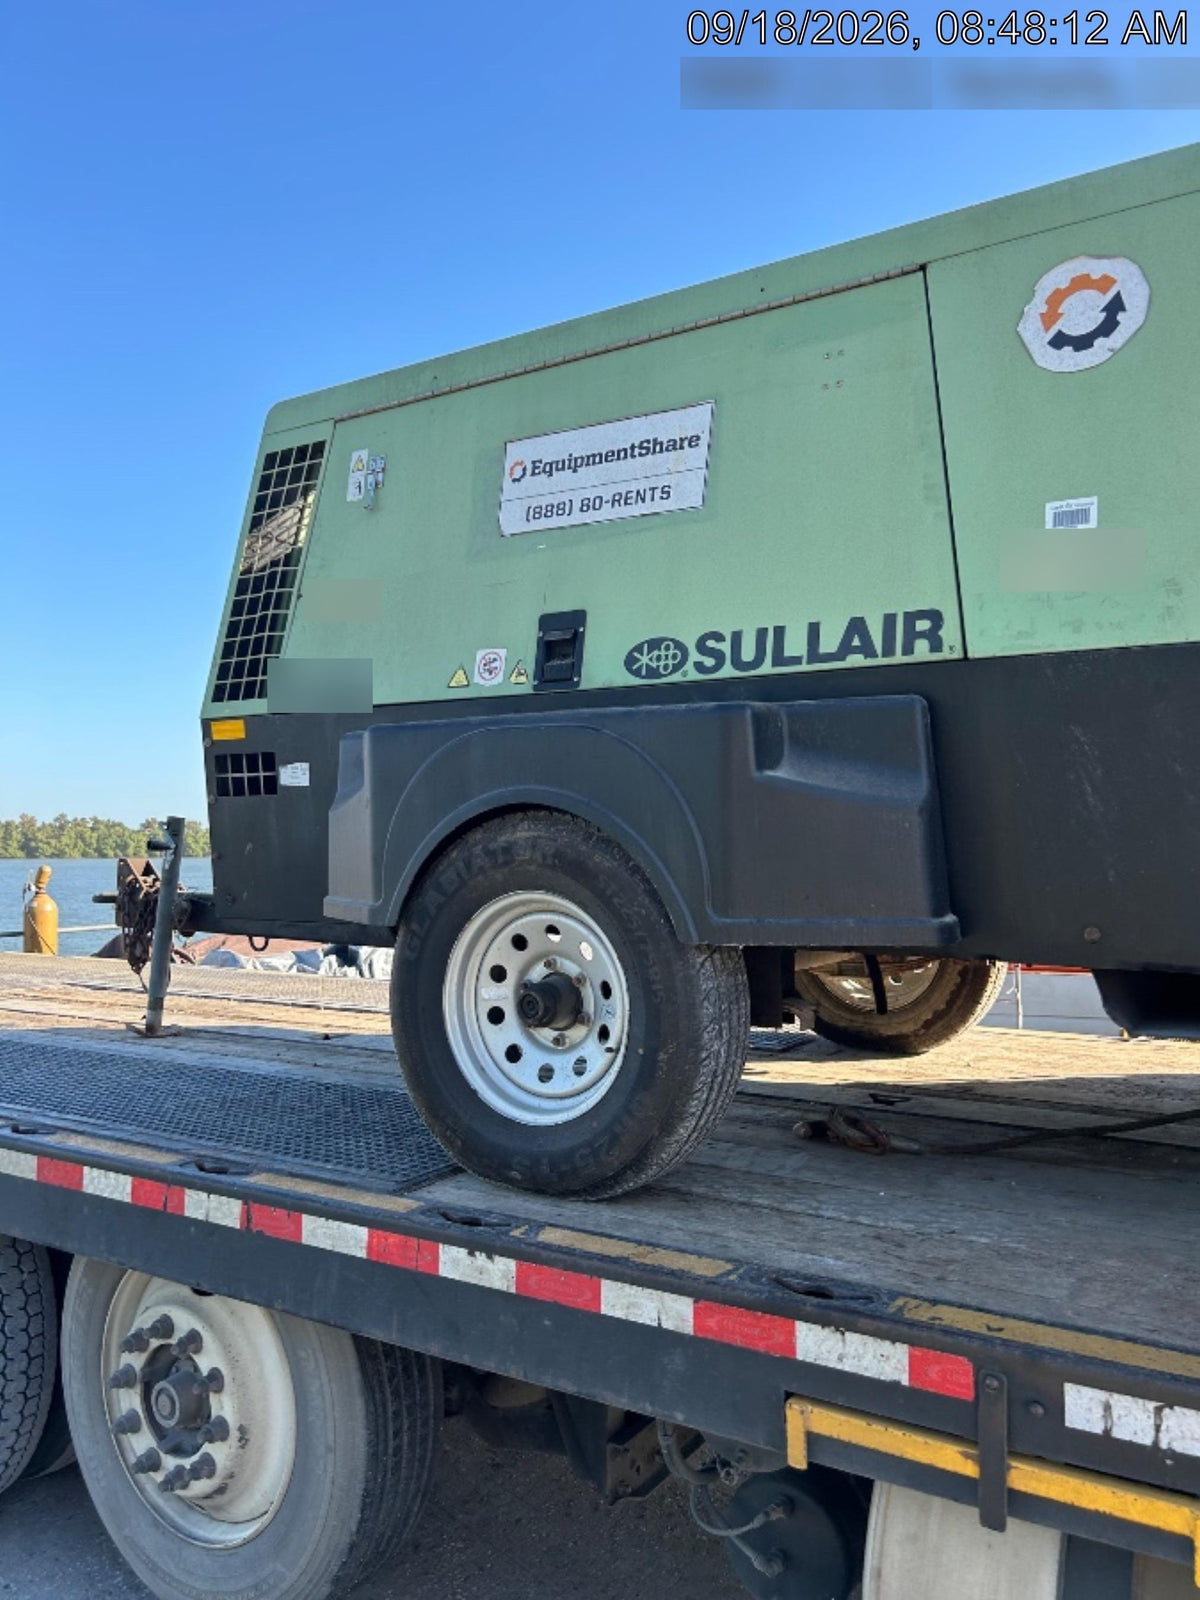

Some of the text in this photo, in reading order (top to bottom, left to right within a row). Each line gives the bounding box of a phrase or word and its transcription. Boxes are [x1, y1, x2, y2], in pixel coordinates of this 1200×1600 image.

[530, 434, 700, 478] EquipmentShare
[525, 485, 672, 522] (888) 80-RENTS
[692, 608, 945, 676] SULLAIR
[404, 835, 558, 960] GLADIATOR
